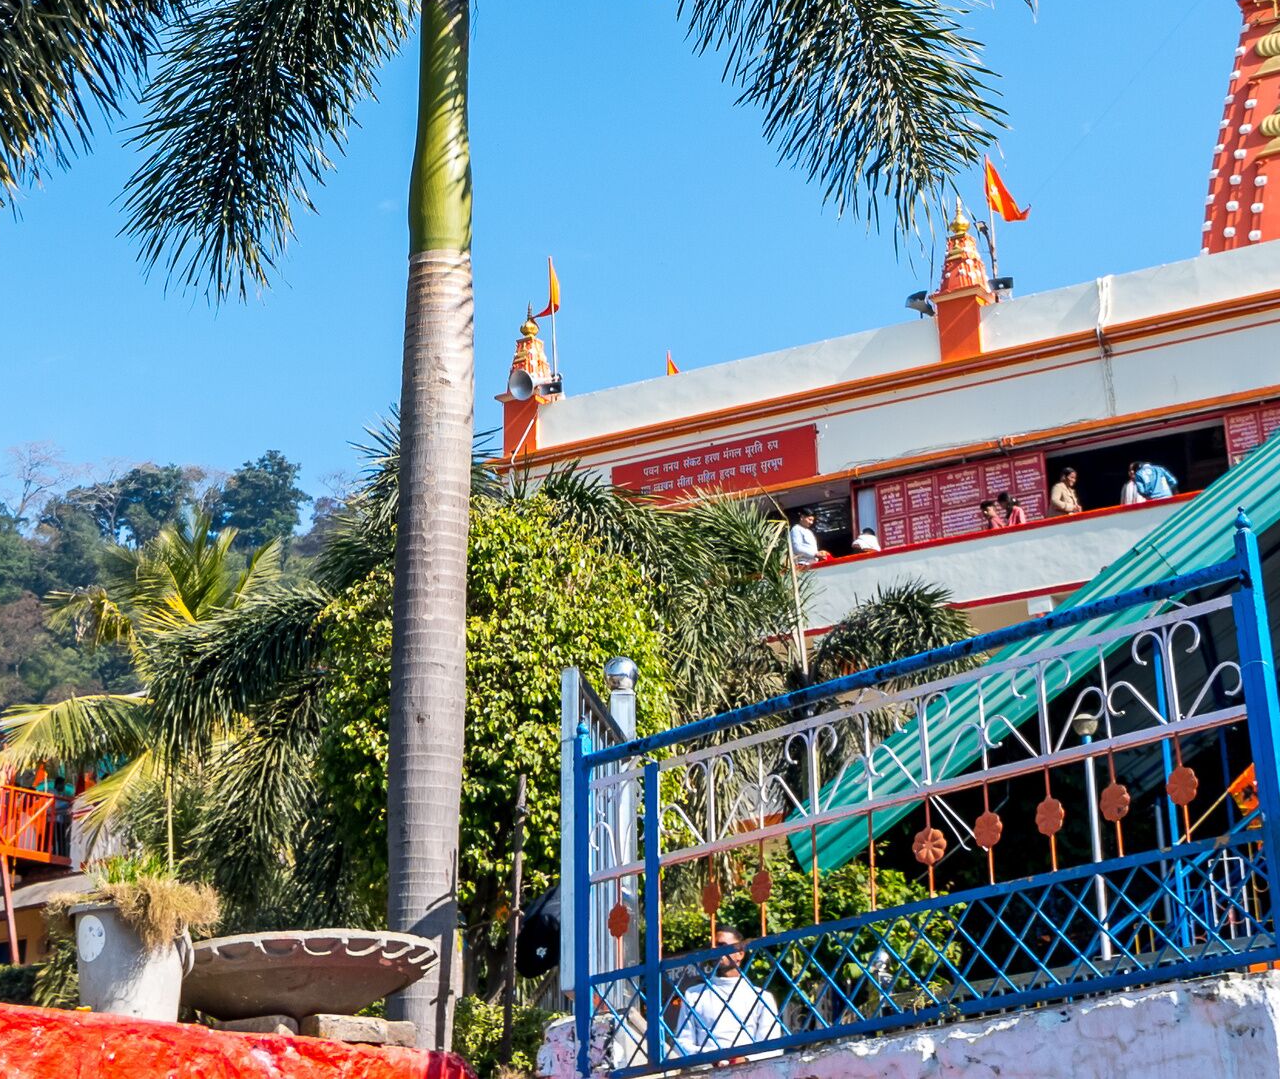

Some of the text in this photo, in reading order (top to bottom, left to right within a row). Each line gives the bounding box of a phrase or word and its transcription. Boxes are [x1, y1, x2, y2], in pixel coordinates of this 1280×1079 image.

[643, 465, 659, 476] पवन
[683, 456, 701, 469] संकट
[704, 452, 720, 465] हरण
[723, 447, 741, 459] मंगल
[745, 440, 763, 458] मूरति
[677, 475, 693, 488] सीता
[697, 469, 715, 484] सहित
